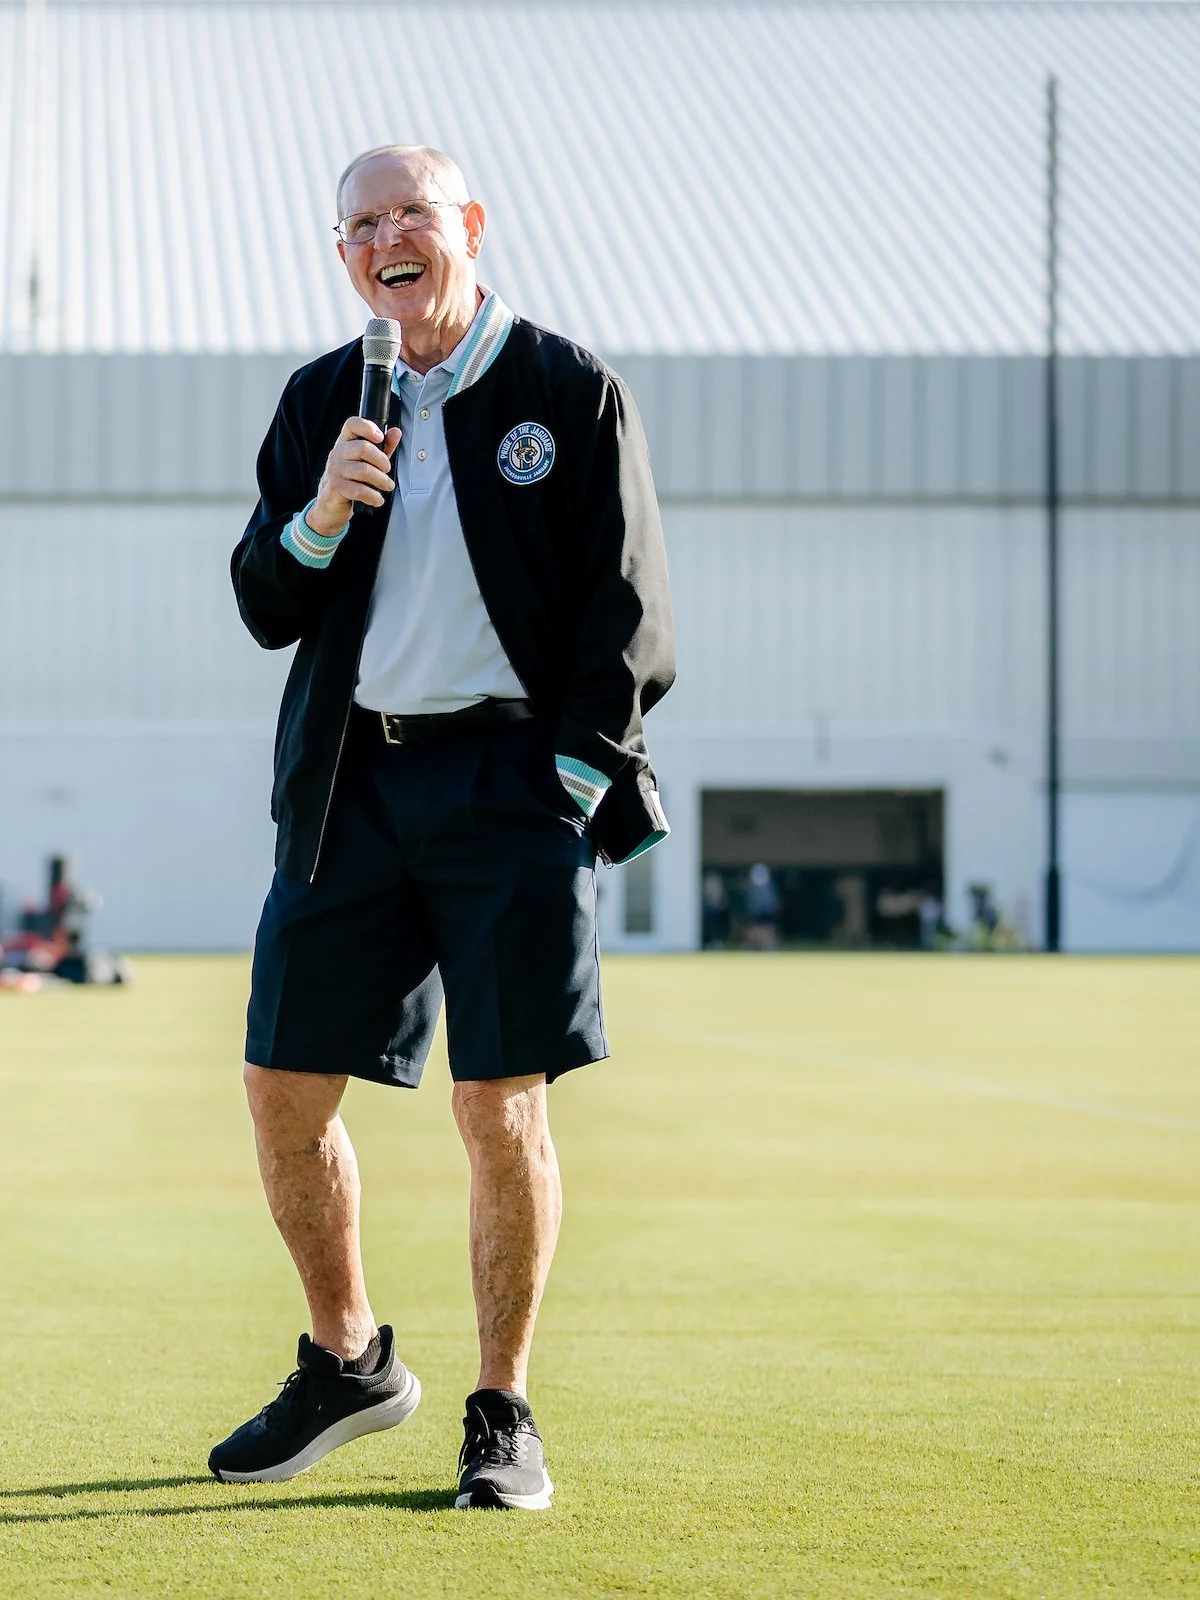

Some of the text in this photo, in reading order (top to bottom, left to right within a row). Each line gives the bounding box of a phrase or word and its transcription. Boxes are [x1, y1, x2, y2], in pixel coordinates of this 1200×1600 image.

[501, 425, 552, 459] PRIDE OF THE JAGUARS
